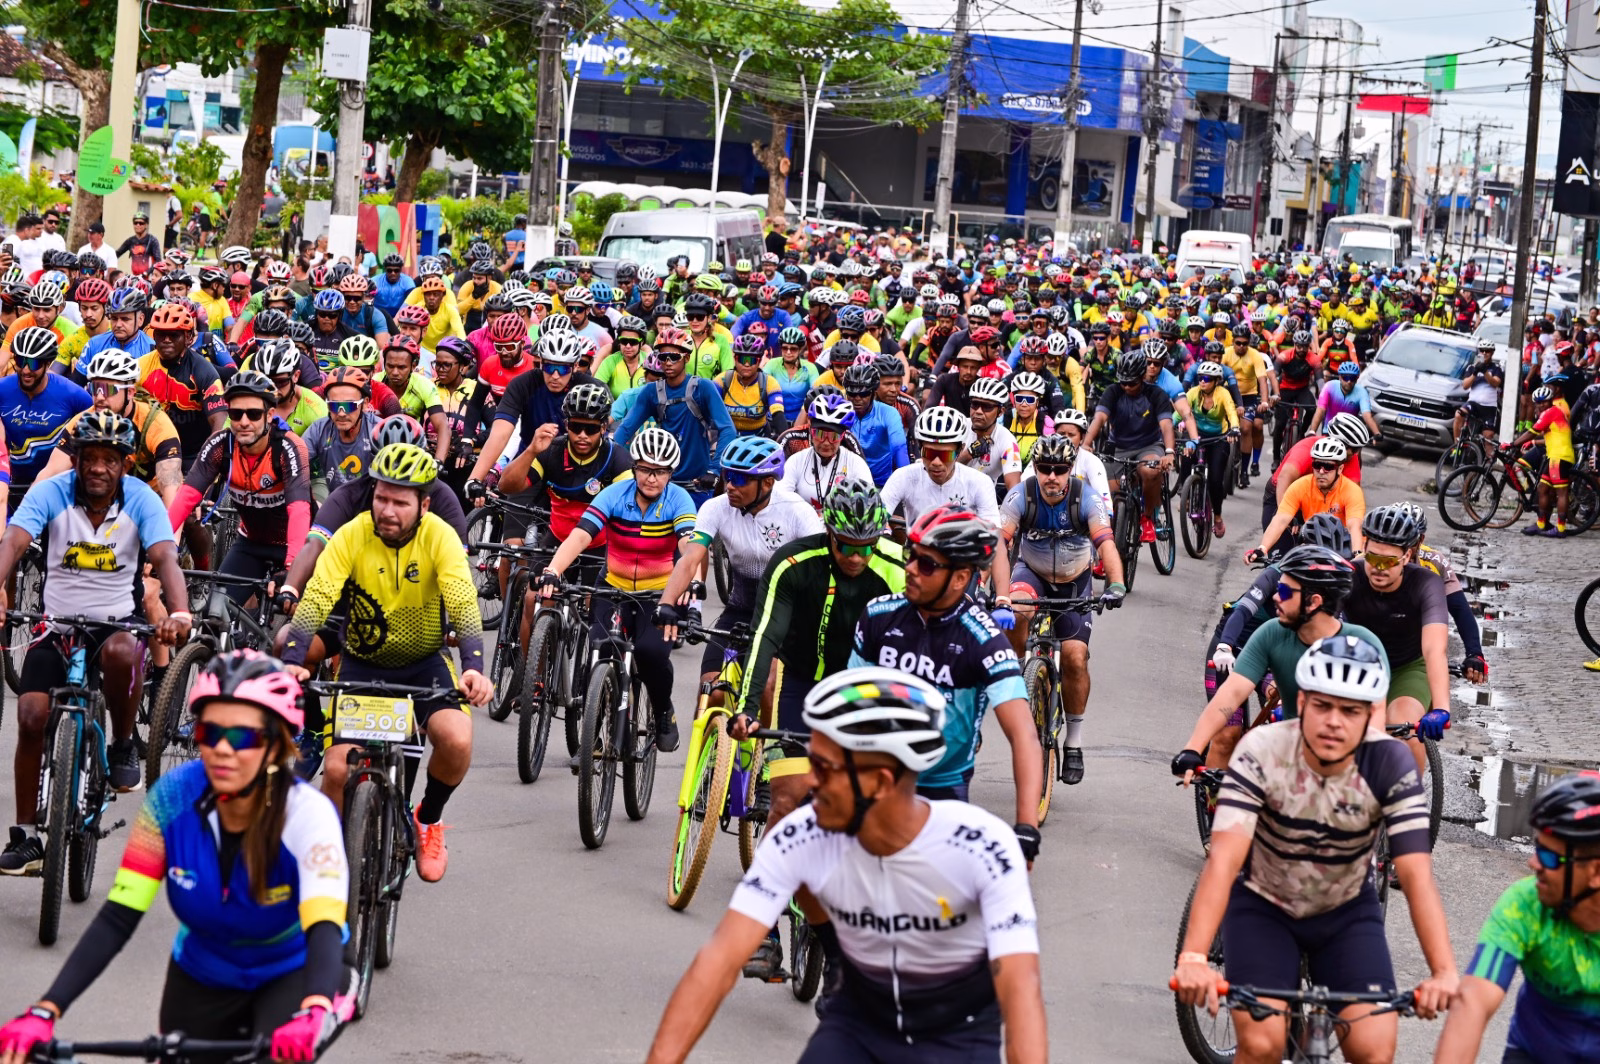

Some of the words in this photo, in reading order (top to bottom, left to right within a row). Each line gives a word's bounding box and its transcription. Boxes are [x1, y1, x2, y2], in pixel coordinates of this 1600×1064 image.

[570, 152, 606, 161] MINOVOS
[66, 540, 117, 552] MANDACARU
[879, 645, 955, 687] BORA
[364, 713, 407, 731] 506
